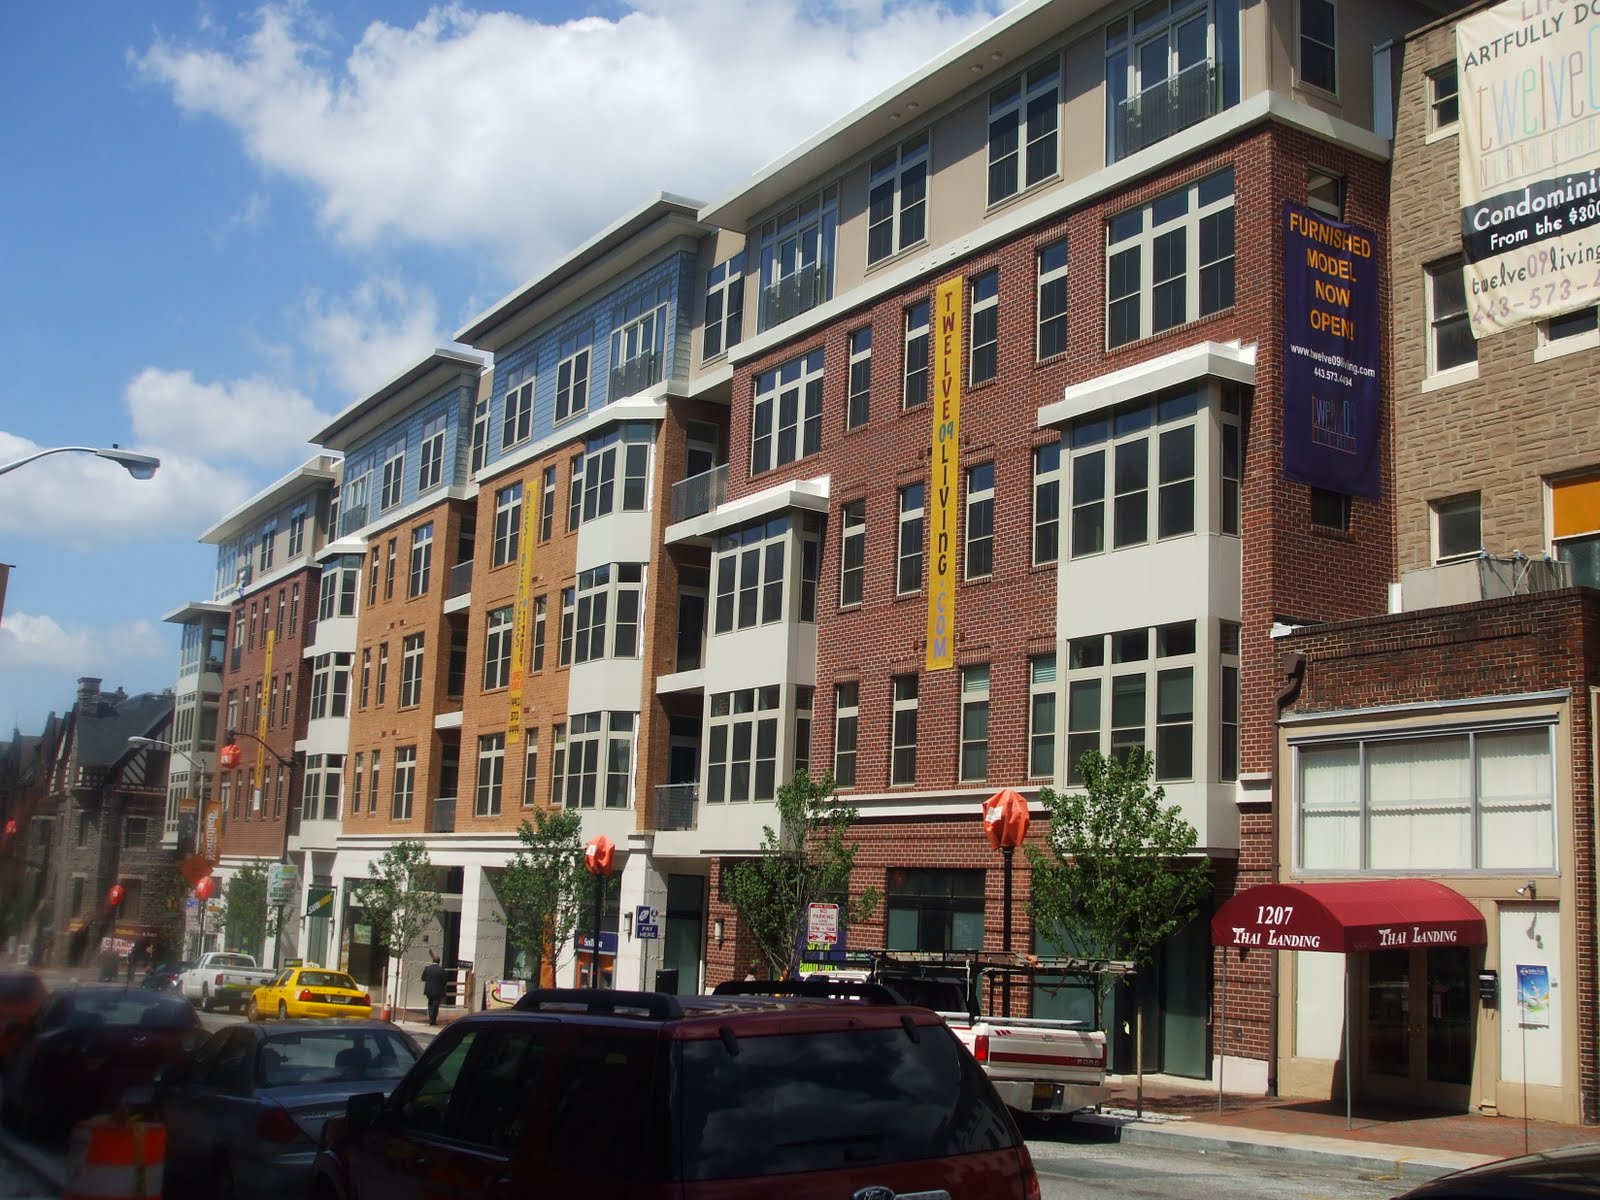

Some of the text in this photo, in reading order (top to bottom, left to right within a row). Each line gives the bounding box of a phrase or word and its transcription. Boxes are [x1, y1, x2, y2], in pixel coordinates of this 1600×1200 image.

[1463, 11, 1564, 72] ARTFULLY
[1473, 169, 1600, 231] Condomini
[1289, 212, 1371, 258] FURNISHED
[1490, 228, 1528, 251] From
[1536, 215, 1563, 236] the
[1306, 247, 1357, 282] MODEL
[1315, 279, 1351, 308] NOW
[1310, 309, 1354, 341] OPEN!
[1256, 906, 1293, 925] 1207
[1232, 927, 1320, 948] THAI LANDING
[1378, 926, 1457, 946] THAI LANDING
[1077, 1058, 1100, 1066] FORD
